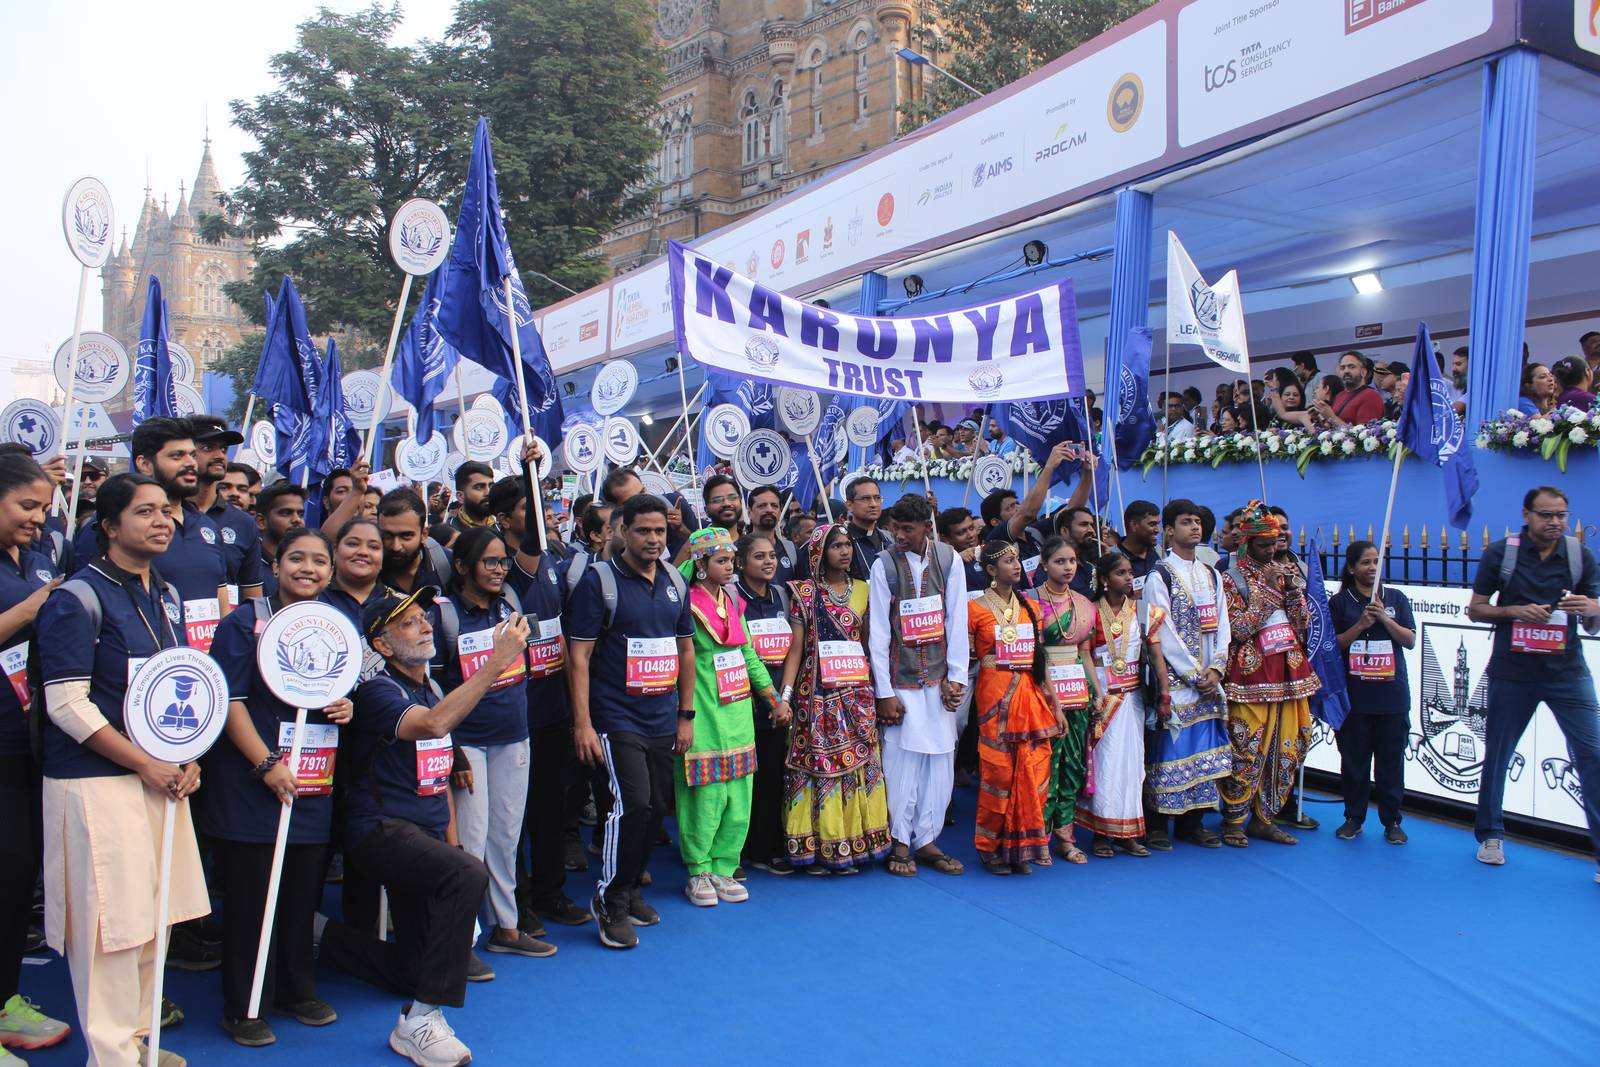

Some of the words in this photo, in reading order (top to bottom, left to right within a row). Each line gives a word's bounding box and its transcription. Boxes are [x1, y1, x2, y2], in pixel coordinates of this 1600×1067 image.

[1213, 22, 1231, 36] Joint
[1232, 14, 1248, 27] Title
[1249, 0, 1281, 19] Sponsor
[1240, 41, 1262, 57] TATA
[1240, 38, 1293, 68] CONSULTANCY
[1204, 59, 1238, 93] tcs
[1240, 58, 1273, 79] SERVICES
[1035, 131, 1087, 163] PROCAM
[987, 157, 1013, 180] AIMS
[694, 257, 1051, 363] KARUNYA
[1180, 324, 1199, 335] LEA
[823, 357, 922, 398] TRUST
[1122, 370, 1134, 398] RUNYA
[1453, 408, 1462, 439] RUST
[188, 623, 219, 641] 1048
[285, 618, 324, 639] KARUNYA
[325, 622, 345, 646] TRUST
[908, 613, 943, 629] 104849
[1518, 627, 1564, 641] 115079
[758, 636, 790, 649] 104775
[1307, 624, 1321, 654] TRUST
[637, 658, 676, 673] 104828
[828, 658, 865, 670] 104859
[133, 693, 142, 707] We
[138, 660, 164, 693] Empower
[165, 654, 185, 664] Lives
[188, 654, 214, 675] Through
